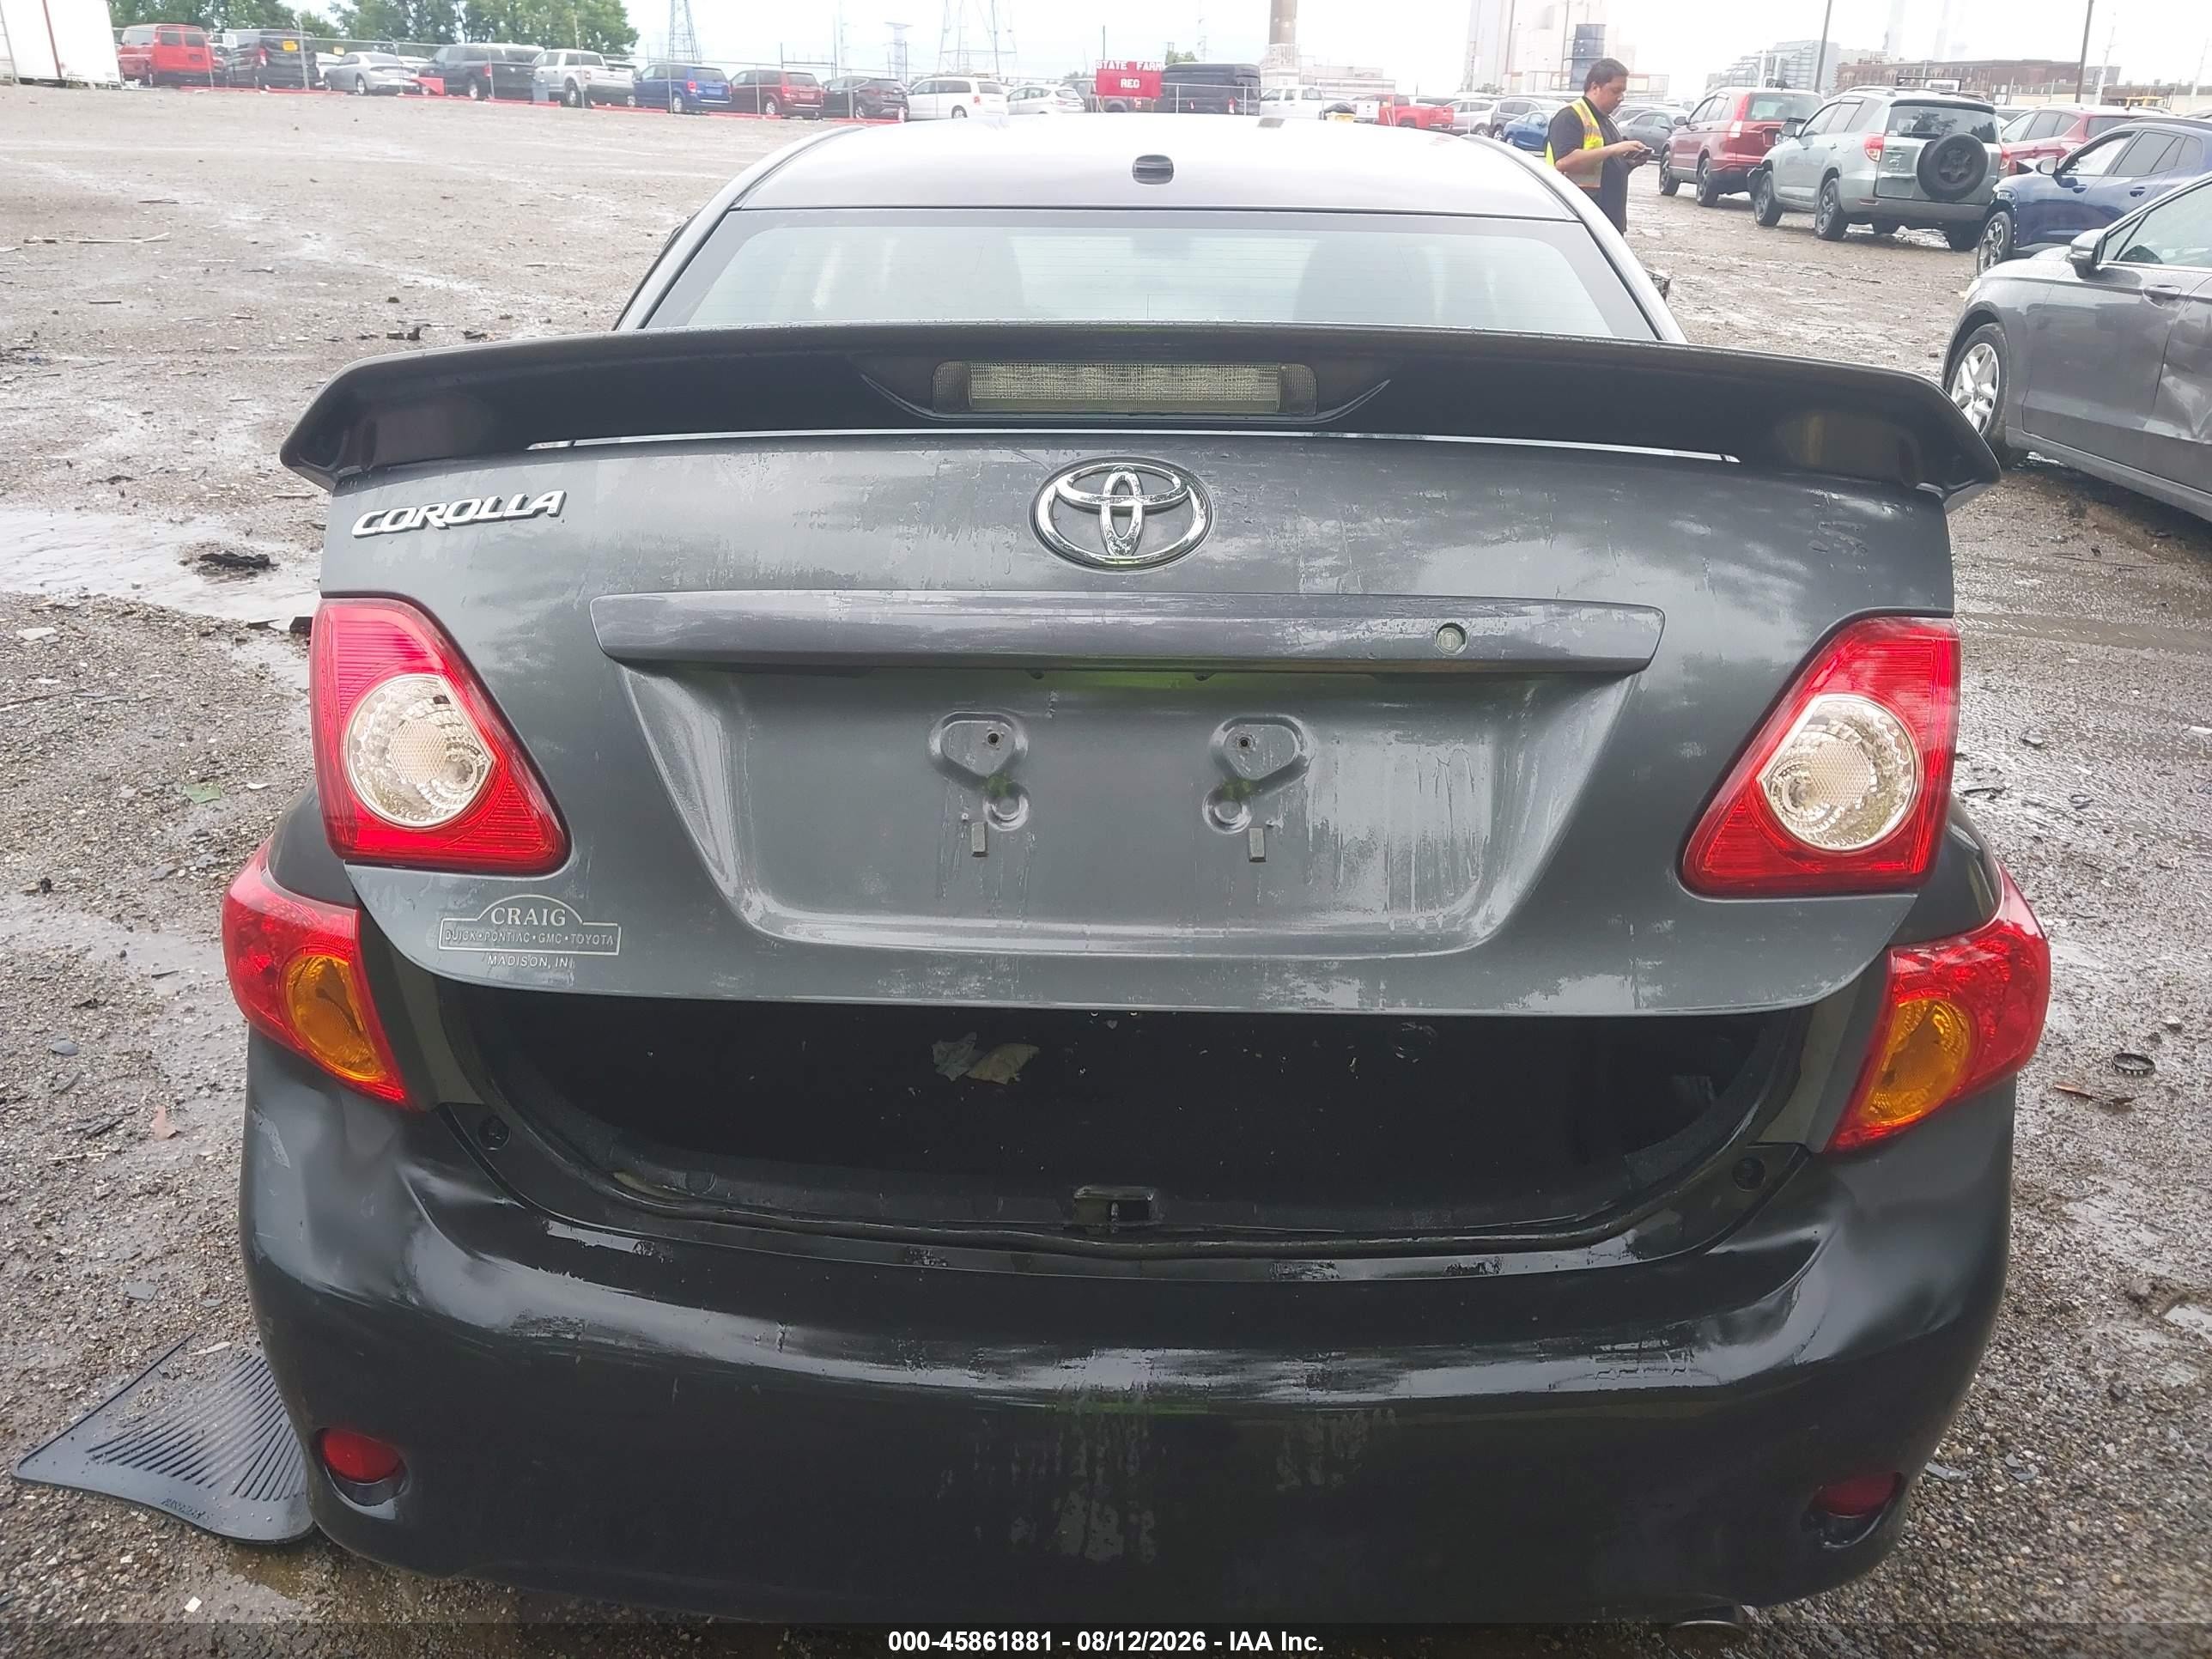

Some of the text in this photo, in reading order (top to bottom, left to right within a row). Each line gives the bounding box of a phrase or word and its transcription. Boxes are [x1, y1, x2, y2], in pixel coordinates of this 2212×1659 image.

[1096, 60, 1164, 71] STATE FARM
[1120, 78, 1140, 88] RED
[351, 490, 567, 538] COROLLA
[490, 907, 567, 927] CRAIG
